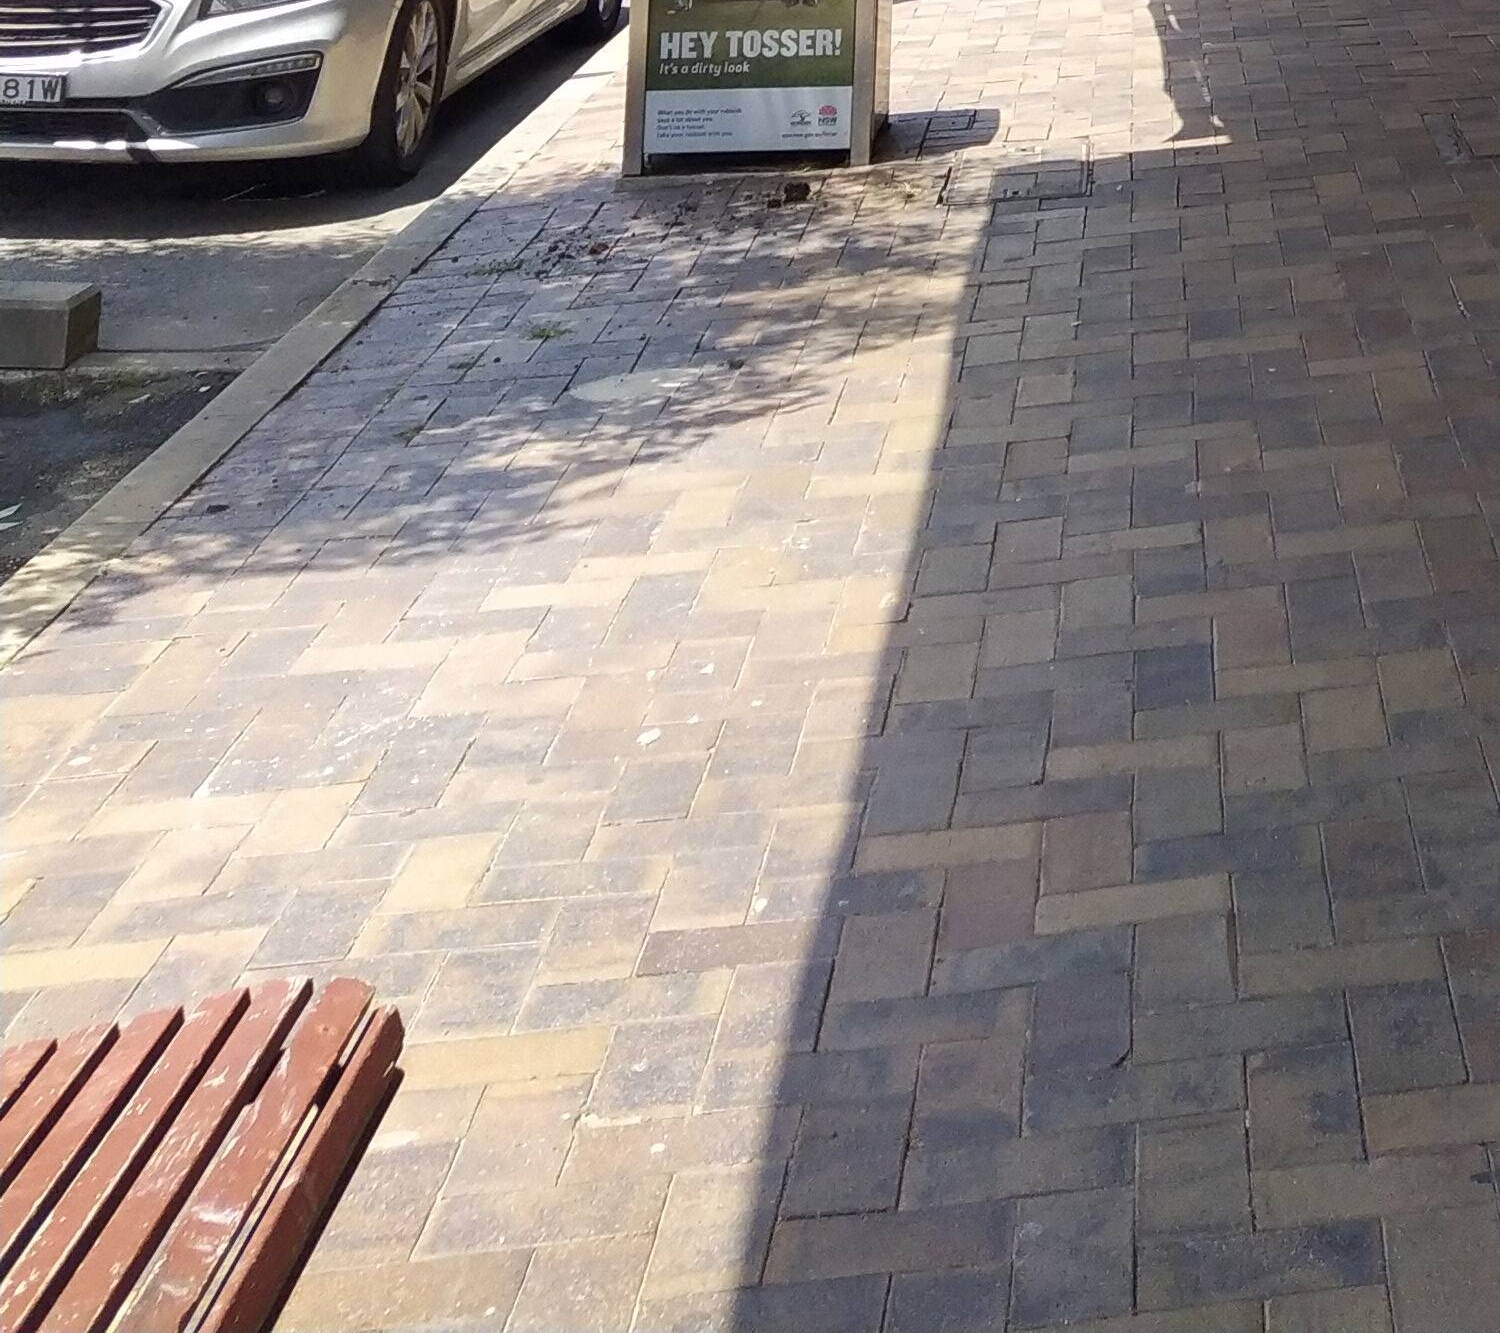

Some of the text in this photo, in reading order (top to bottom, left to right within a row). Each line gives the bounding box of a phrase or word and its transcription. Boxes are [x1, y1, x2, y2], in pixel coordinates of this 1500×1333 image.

[659, 28, 842, 60] HEY TOSSER!
[658, 60, 751, 77] It's a dirty look
